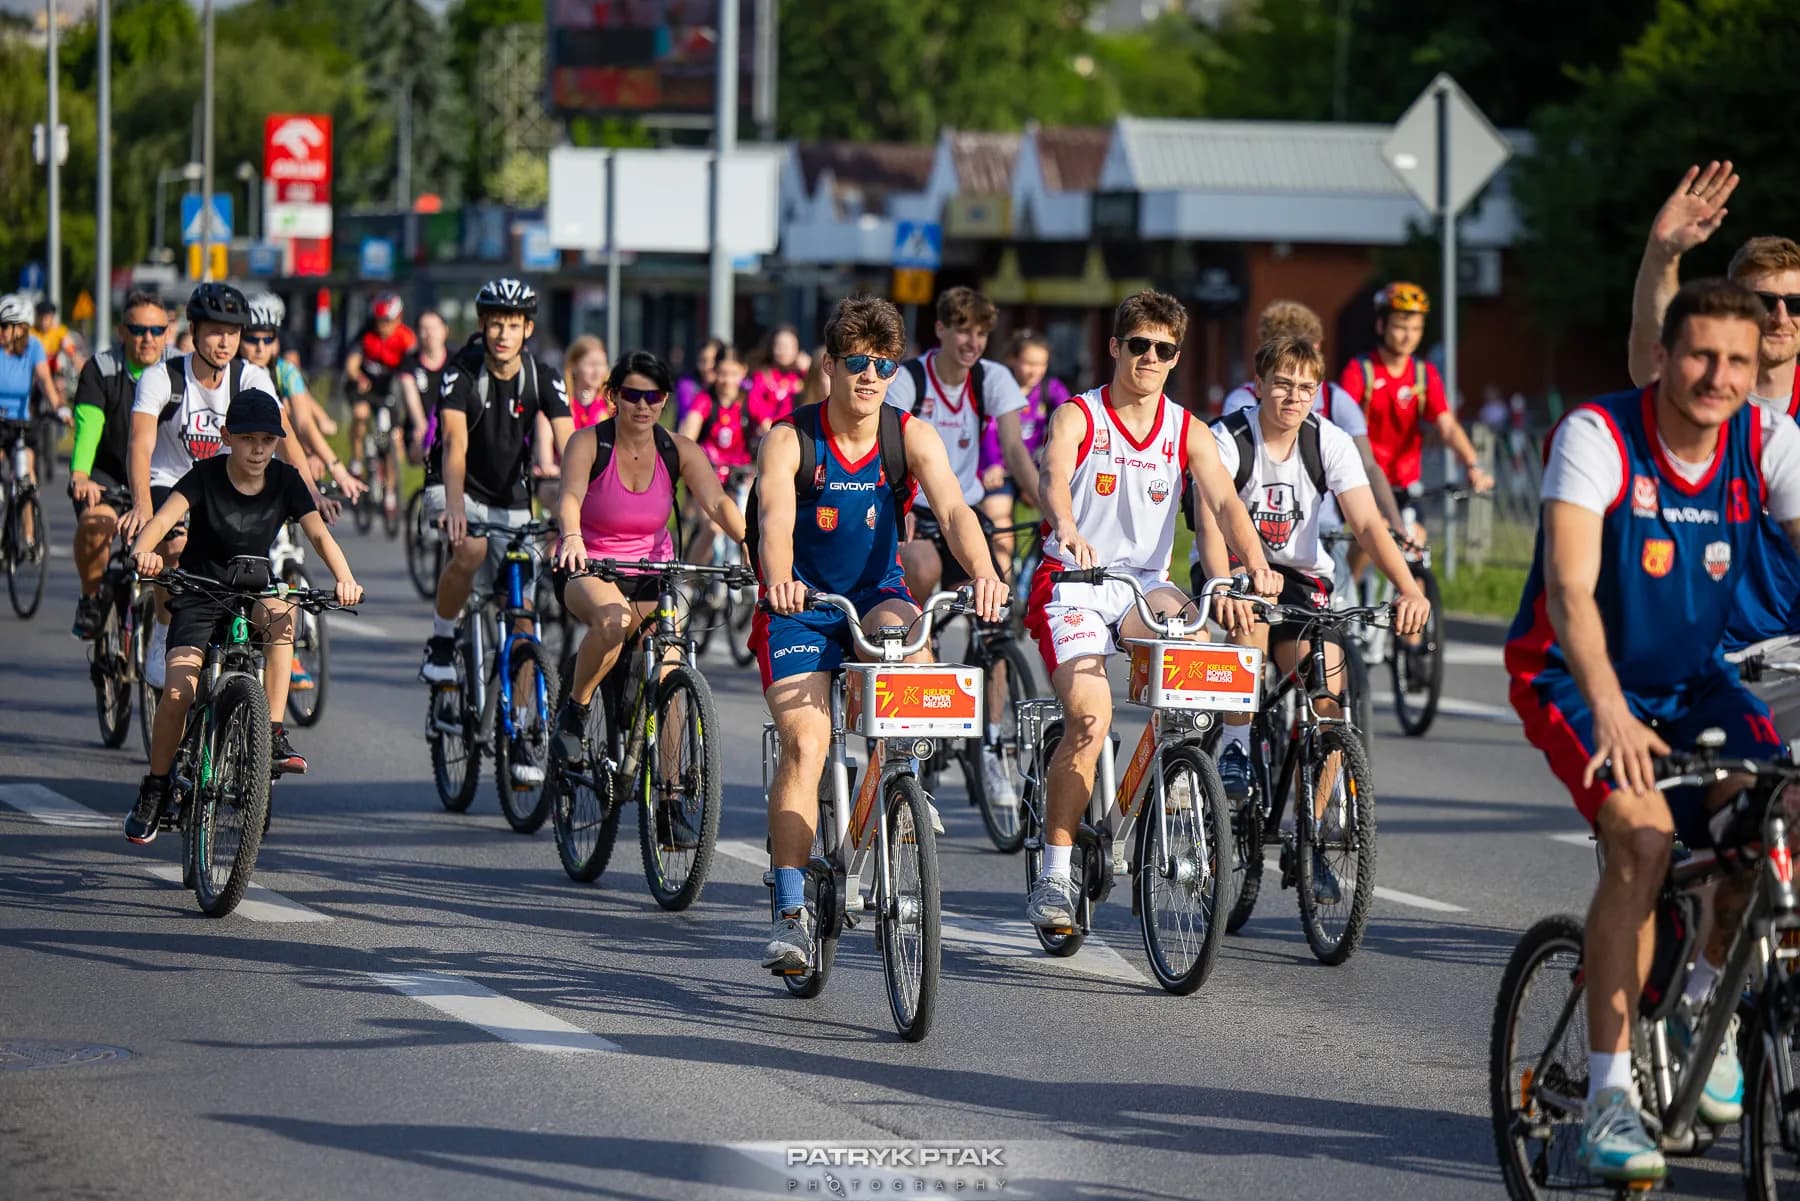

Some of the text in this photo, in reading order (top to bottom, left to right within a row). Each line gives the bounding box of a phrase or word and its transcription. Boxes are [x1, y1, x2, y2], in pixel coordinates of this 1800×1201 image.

[1162, 437, 1174, 464] 4
[830, 482, 876, 491] GIVOVA
[819, 515, 834, 529] CK
[773, 644, 820, 659] GIVOVA
[1207, 664, 1237, 672] KIELECKI
[923, 688, 955, 696] KIELECKI
[923, 701, 951, 709] MIEJSKI
